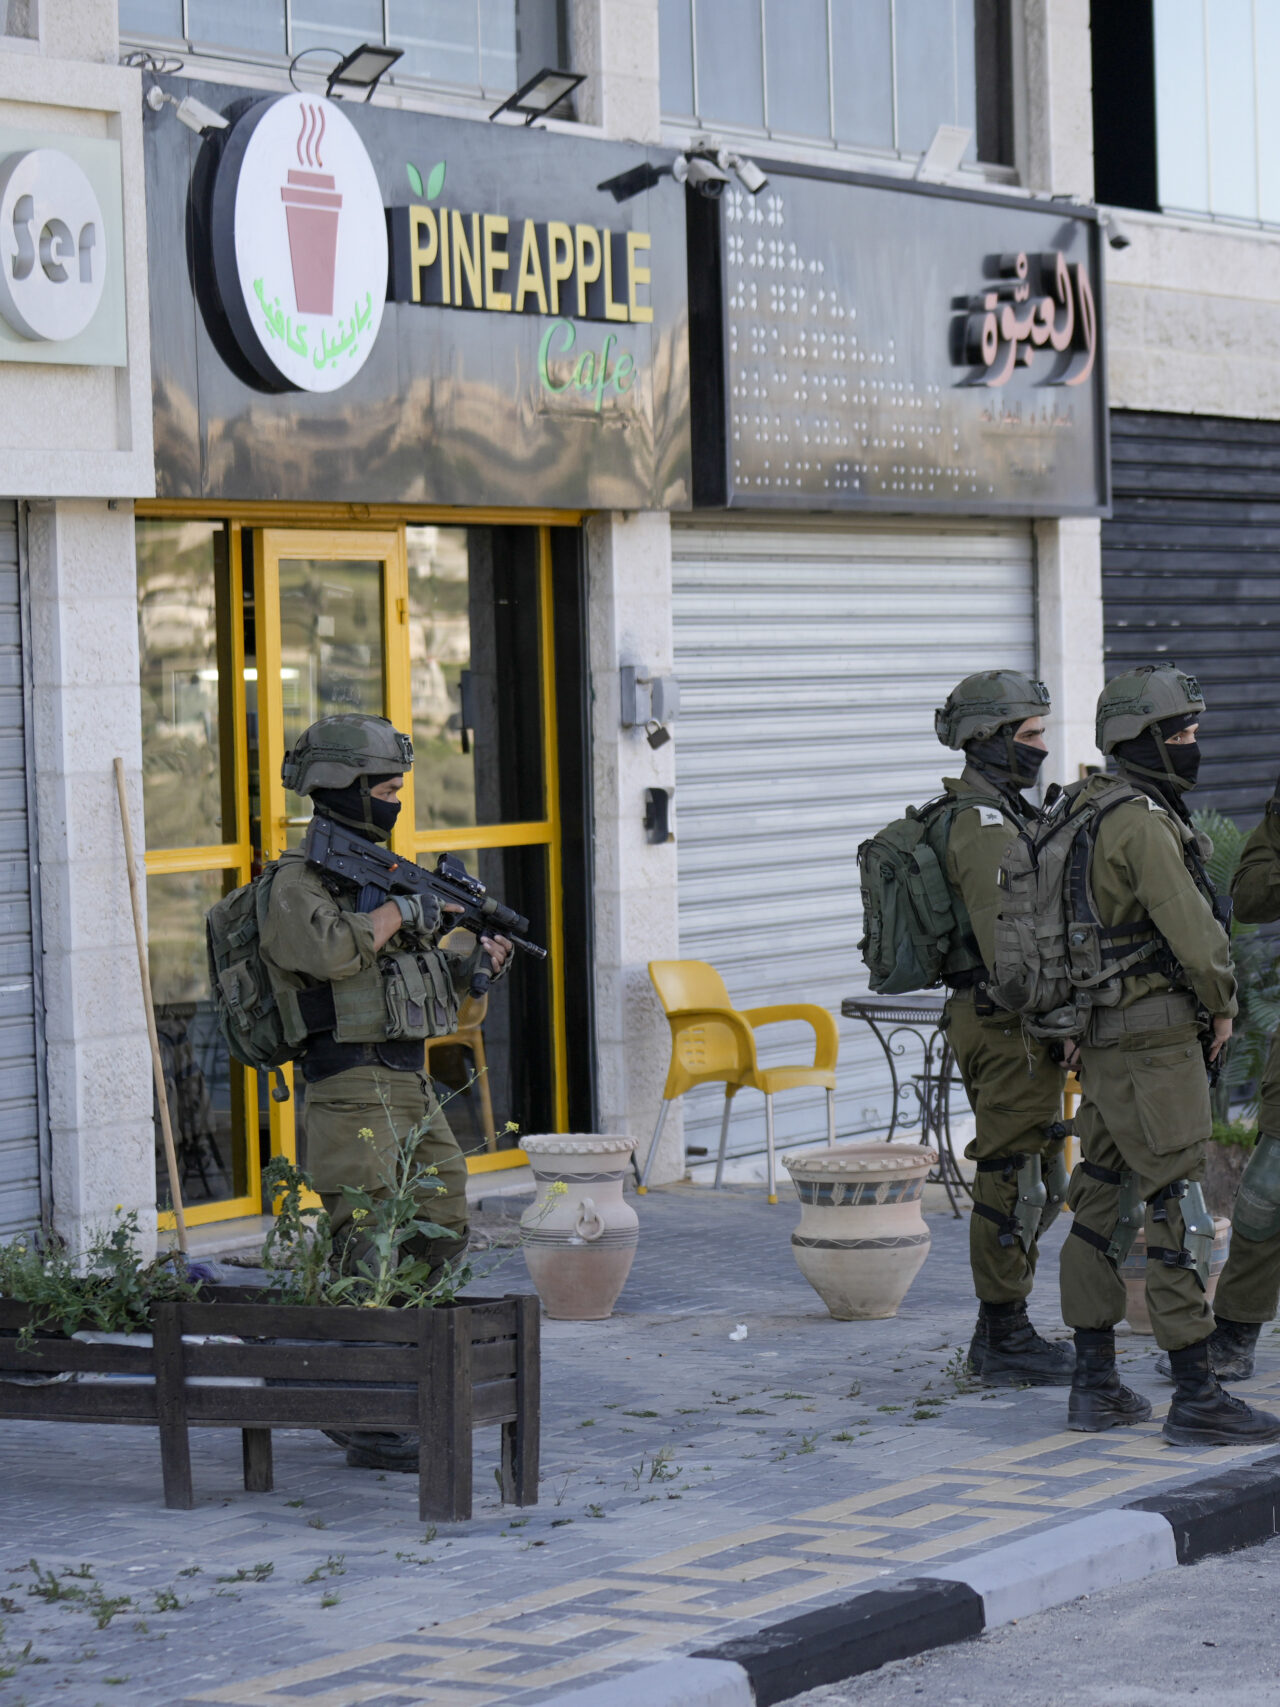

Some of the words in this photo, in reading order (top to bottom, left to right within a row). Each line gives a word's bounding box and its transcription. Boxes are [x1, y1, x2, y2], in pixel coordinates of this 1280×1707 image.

[11, 193, 96, 283] Ser
[408, 204, 655, 323] PINEAPPLE
[537, 318, 637, 410] Cafe
